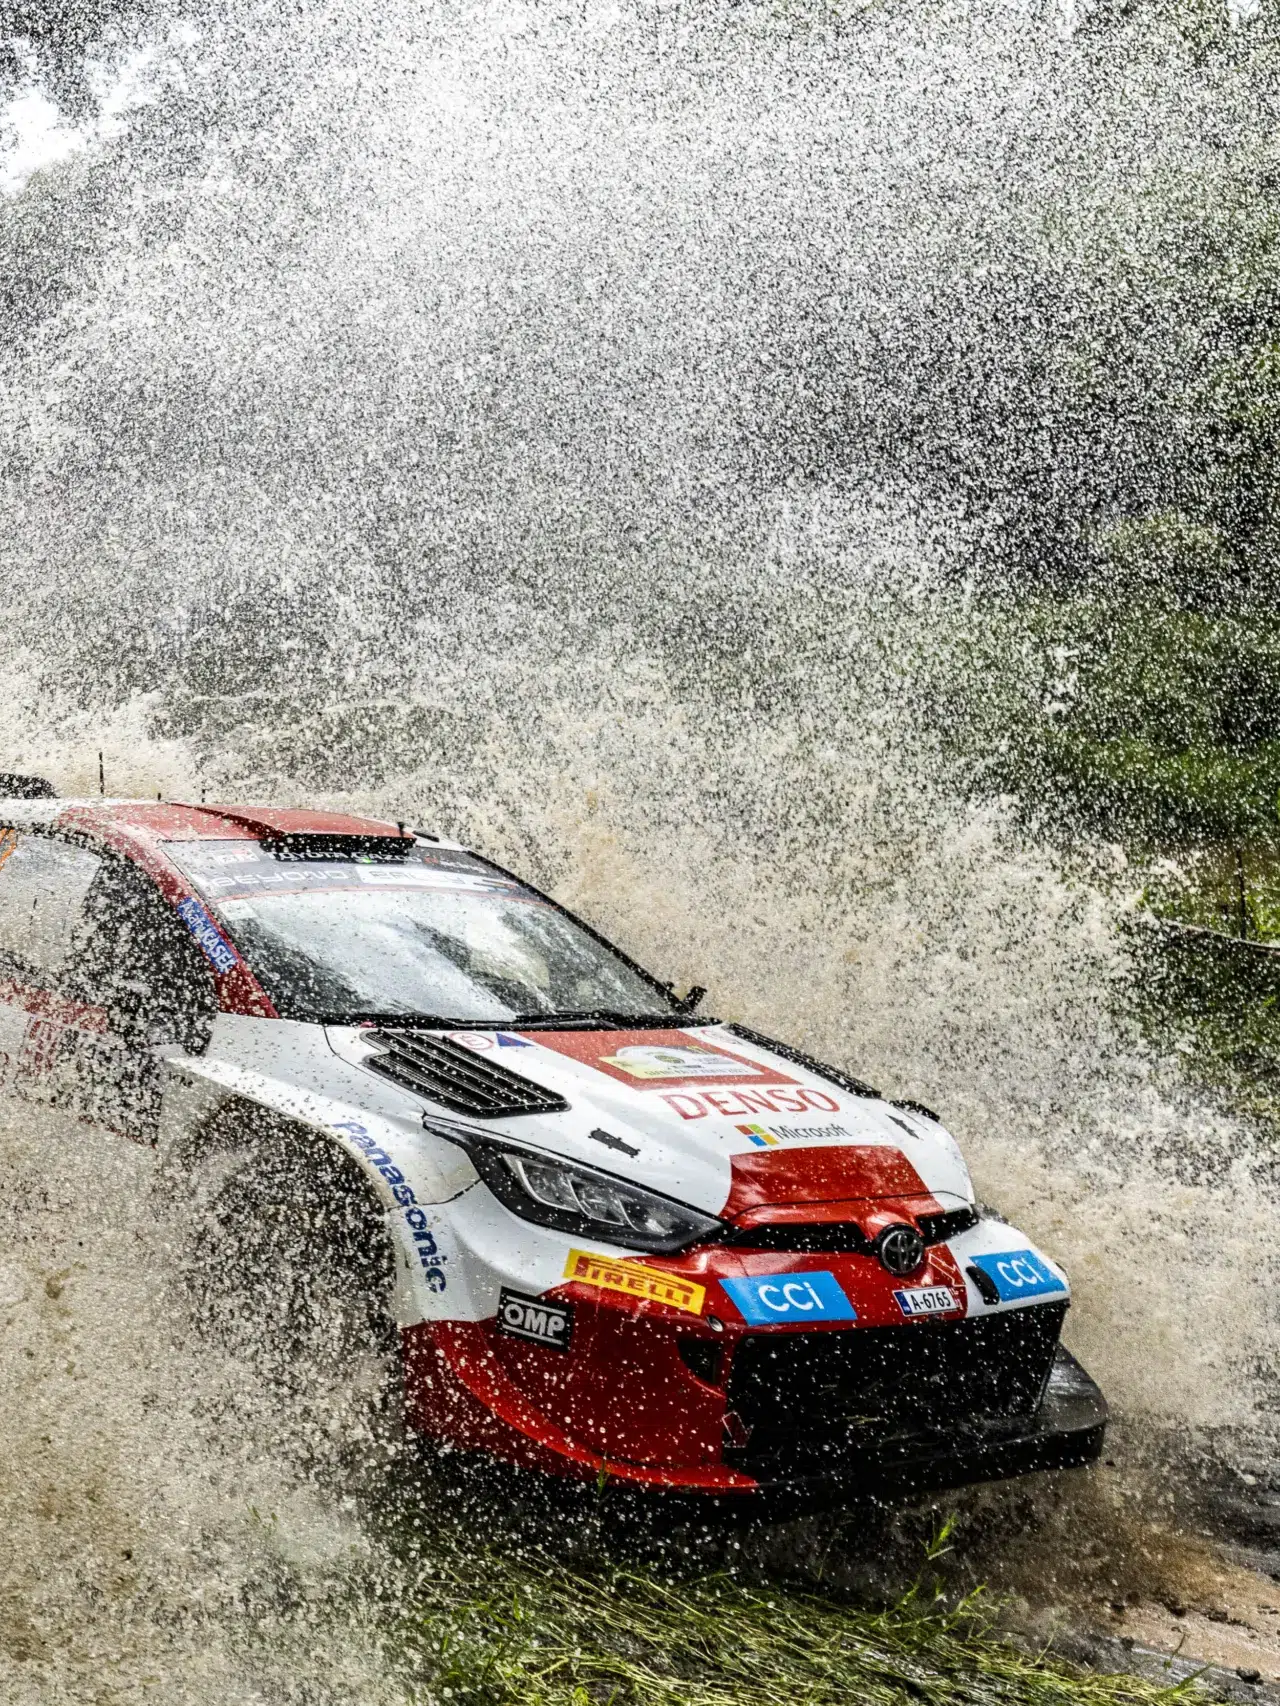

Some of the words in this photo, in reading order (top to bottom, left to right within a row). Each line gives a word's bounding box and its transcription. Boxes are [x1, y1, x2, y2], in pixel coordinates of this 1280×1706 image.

[211, 869, 350, 888] BEYOND
[659, 1088, 840, 1120] DENSO
[768, 1123, 853, 1141] Microsoft
[332, 1121, 448, 1294] Panasonic
[573, 1256, 696, 1306] PIRELLI
[910, 1291, 951, 1311] A-6765
[503, 1303, 566, 1337] OMP
